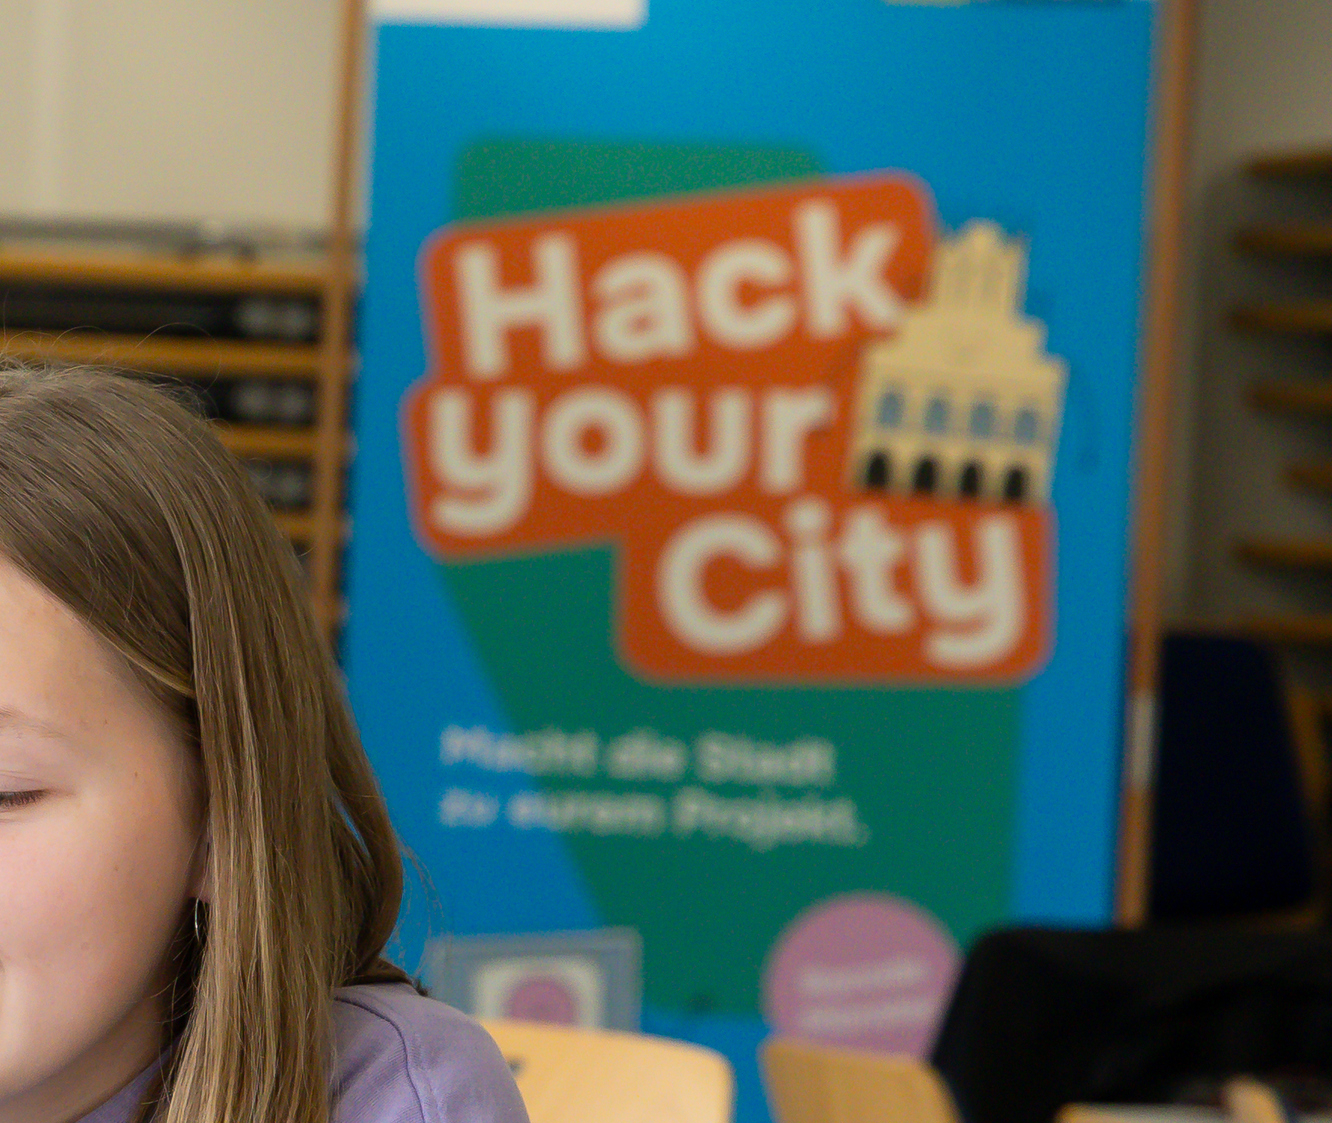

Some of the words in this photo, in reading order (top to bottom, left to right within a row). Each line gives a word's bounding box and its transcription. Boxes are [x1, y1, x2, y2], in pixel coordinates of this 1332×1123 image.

[452, 200, 909, 380] Hack
[427, 386, 835, 537] your
[656, 497, 1027, 669] City
[440, 725, 599, 777] Macht
[607, 727, 686, 781] die
[694, 729, 835, 786] Stadt
